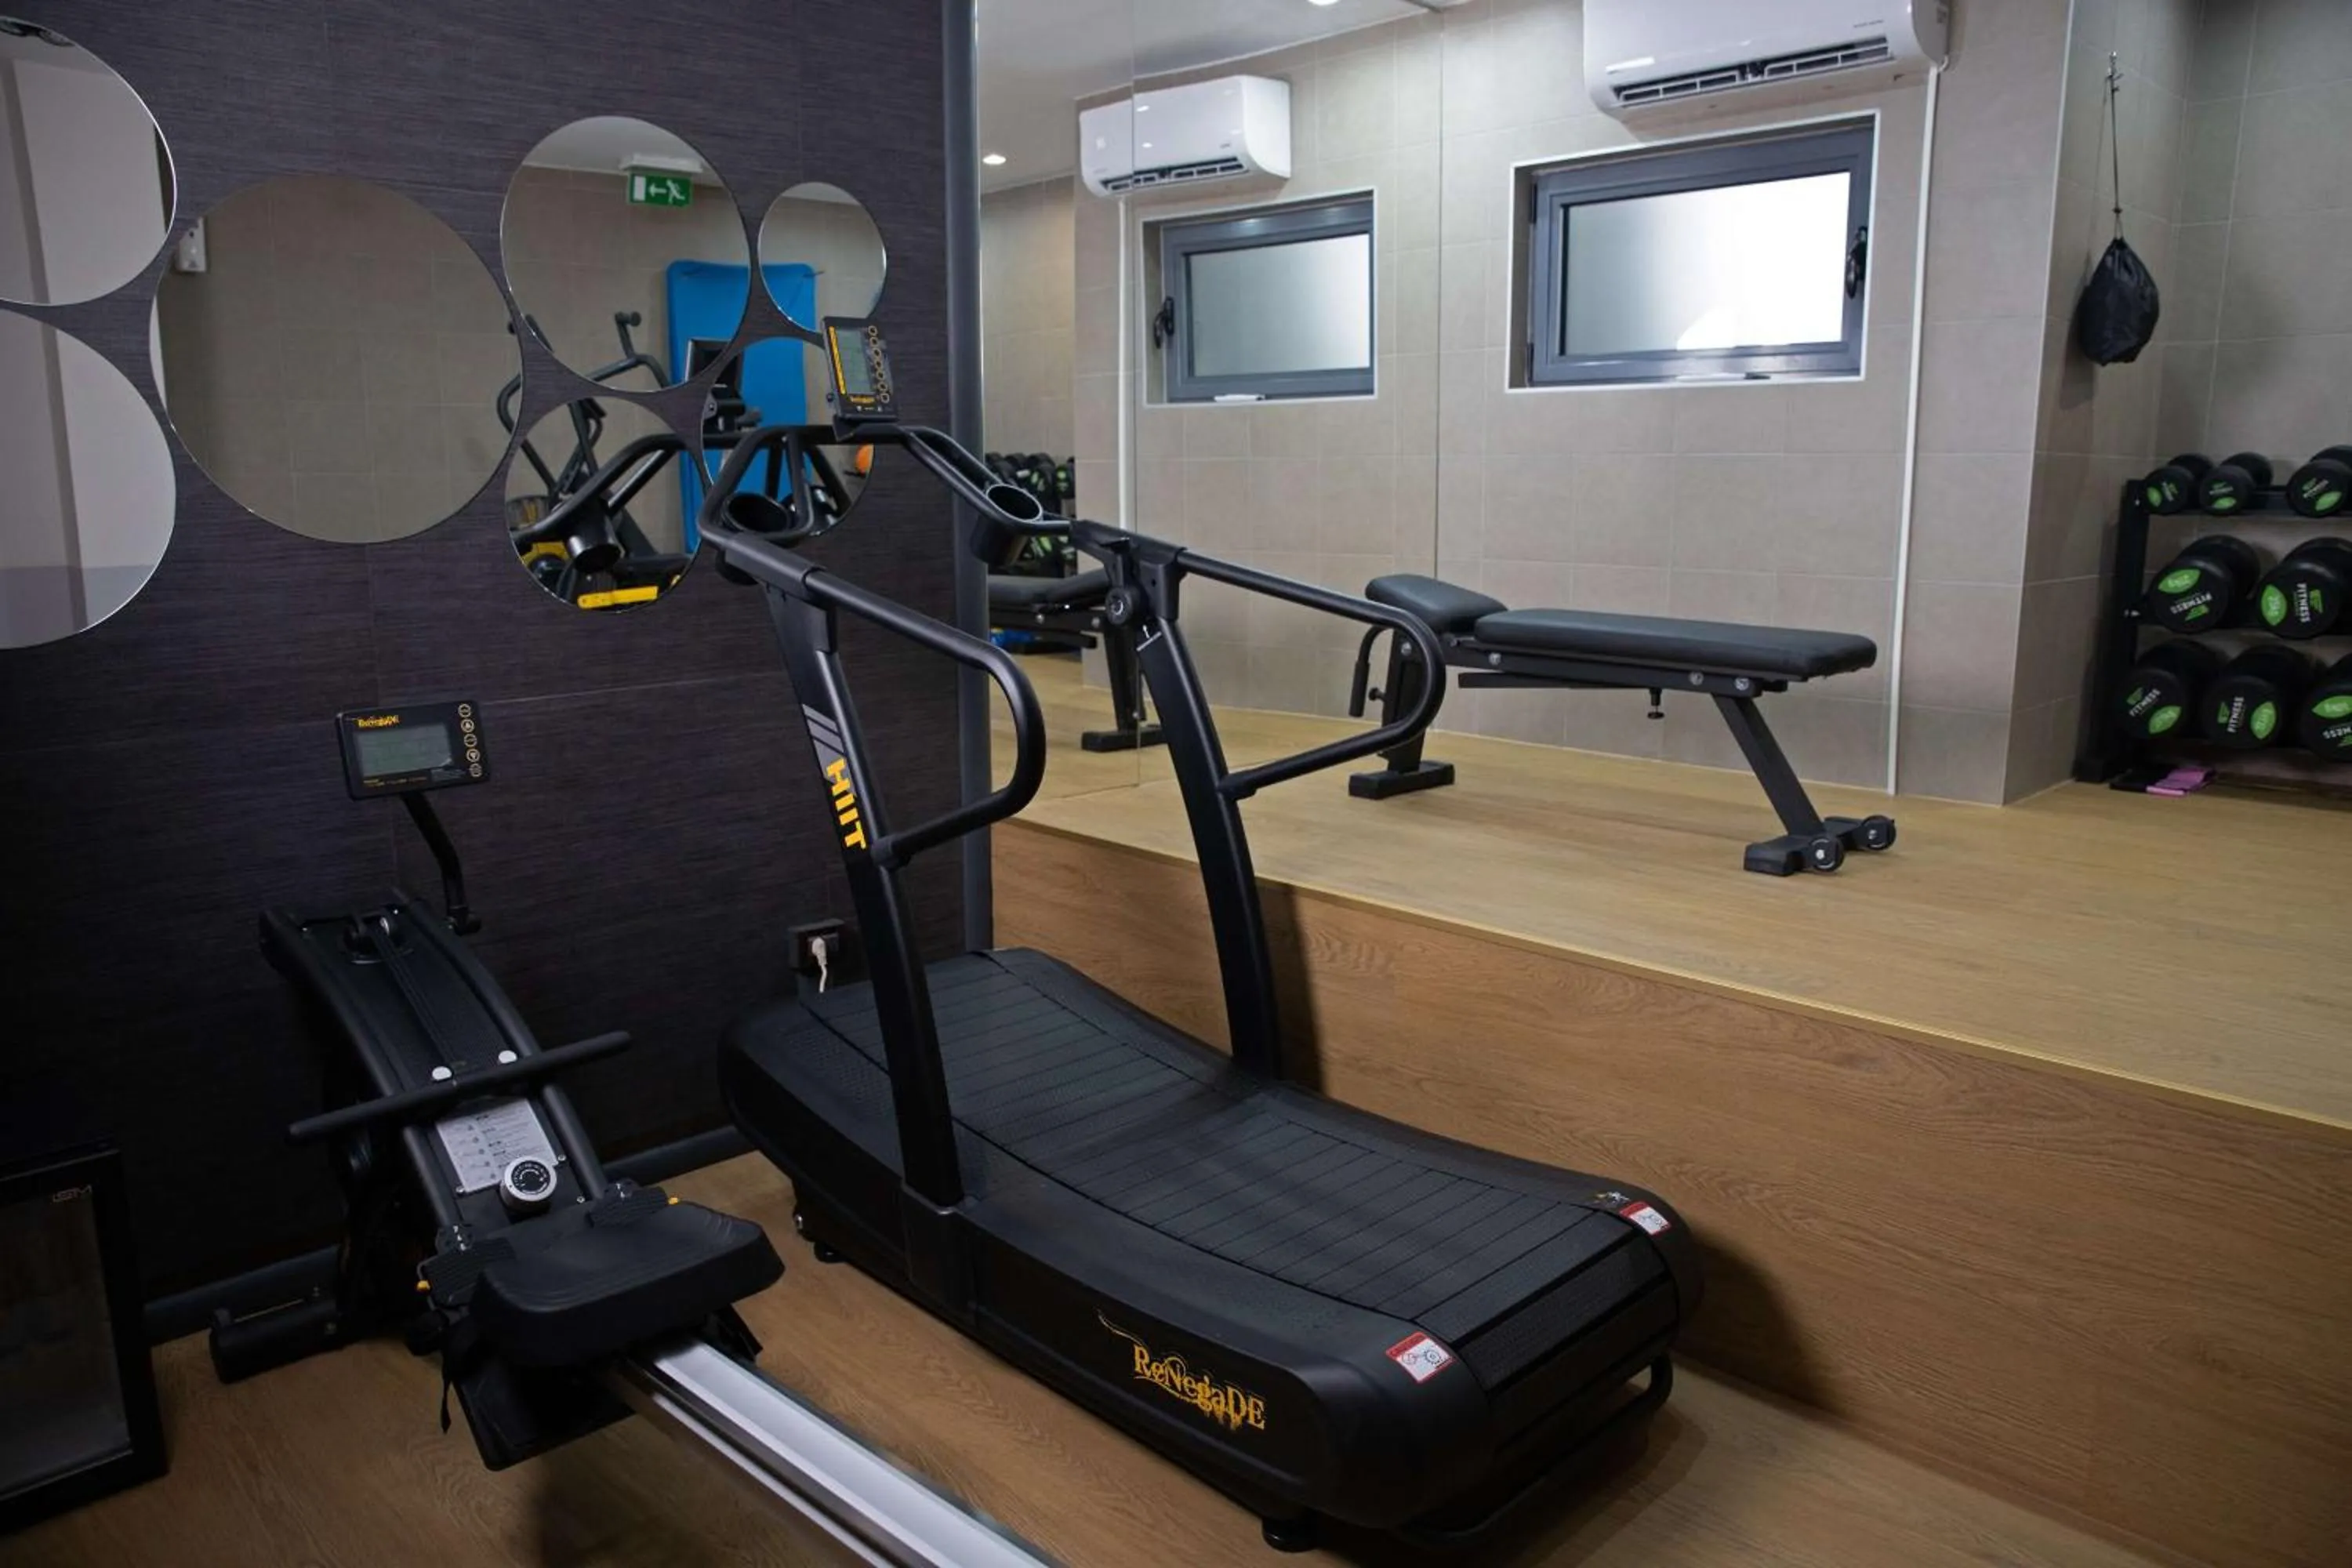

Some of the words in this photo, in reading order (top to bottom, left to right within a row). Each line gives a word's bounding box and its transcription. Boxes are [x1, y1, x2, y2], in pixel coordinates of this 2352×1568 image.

[2296, 583, 2310, 622] FITNESS
[2227, 696, 2245, 733] FITNESS
[826, 757, 866, 849] HIIT
